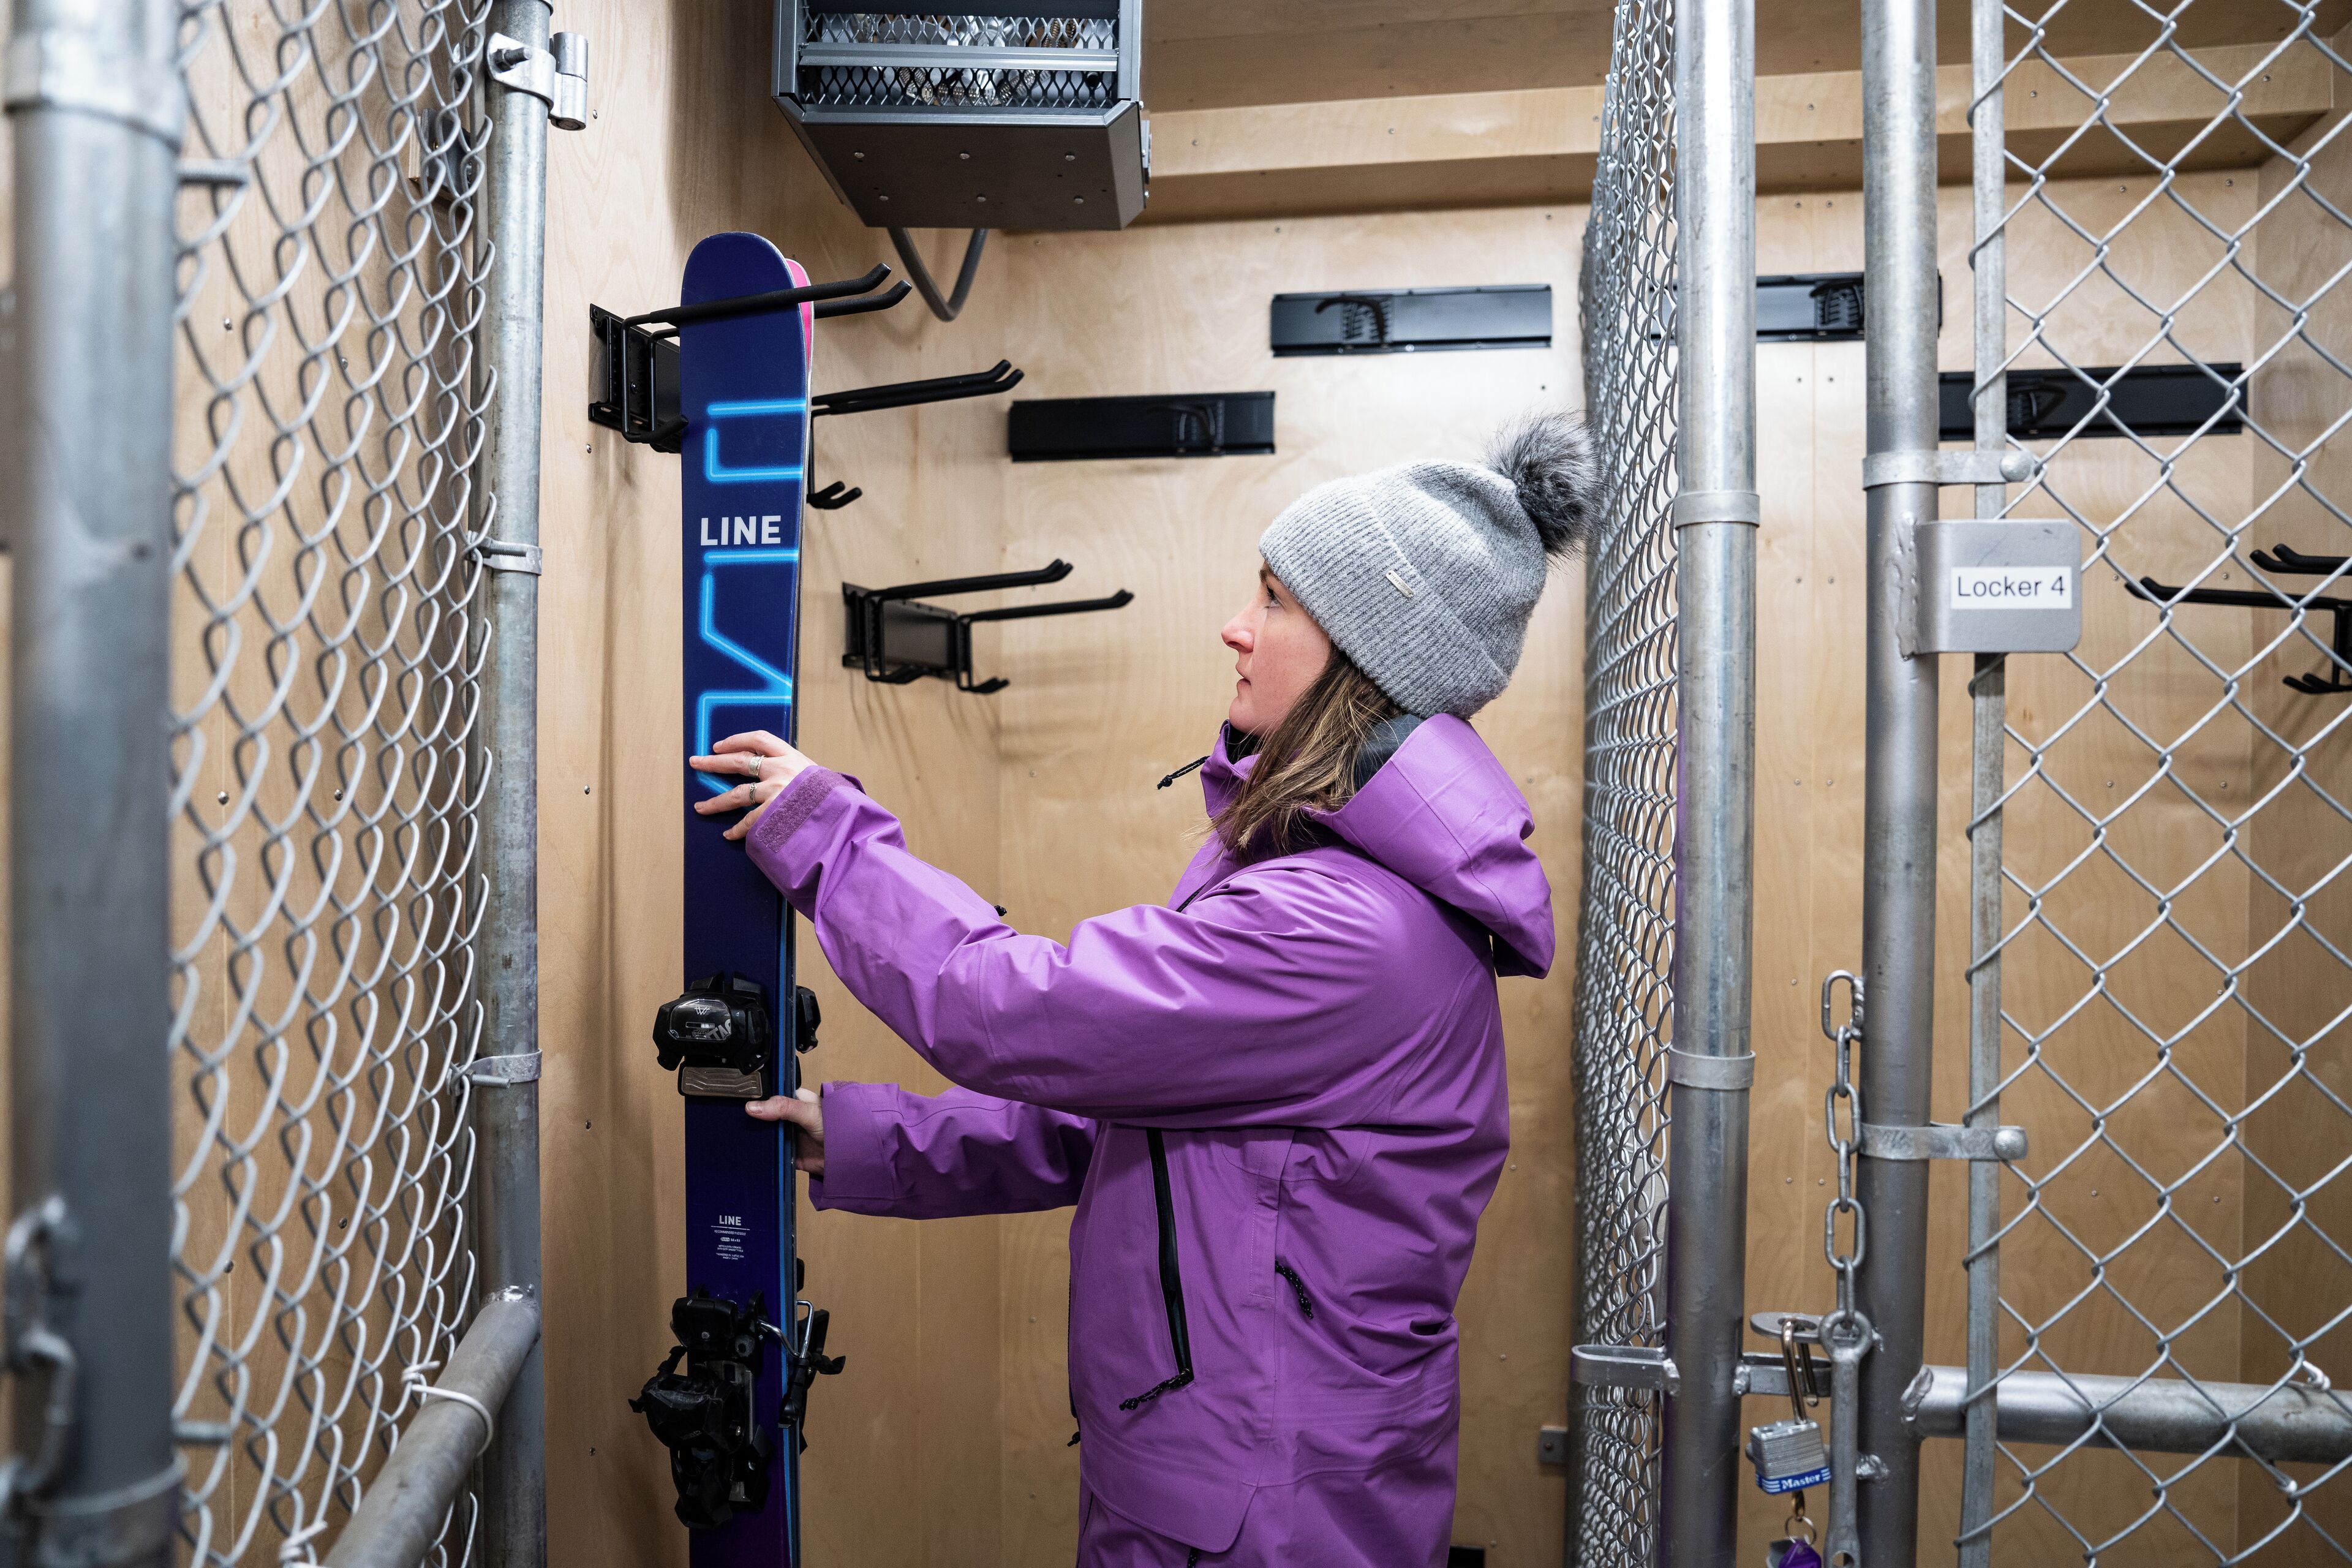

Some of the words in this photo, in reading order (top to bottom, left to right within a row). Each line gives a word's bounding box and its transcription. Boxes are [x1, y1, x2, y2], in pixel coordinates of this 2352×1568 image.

[700, 515, 782, 546] LINE
[1957, 576, 2041, 597] Locker
[2051, 576, 2065, 596] 4
[719, 1215, 742, 1226] LINE
[1781, 1474, 1821, 1490] Master
